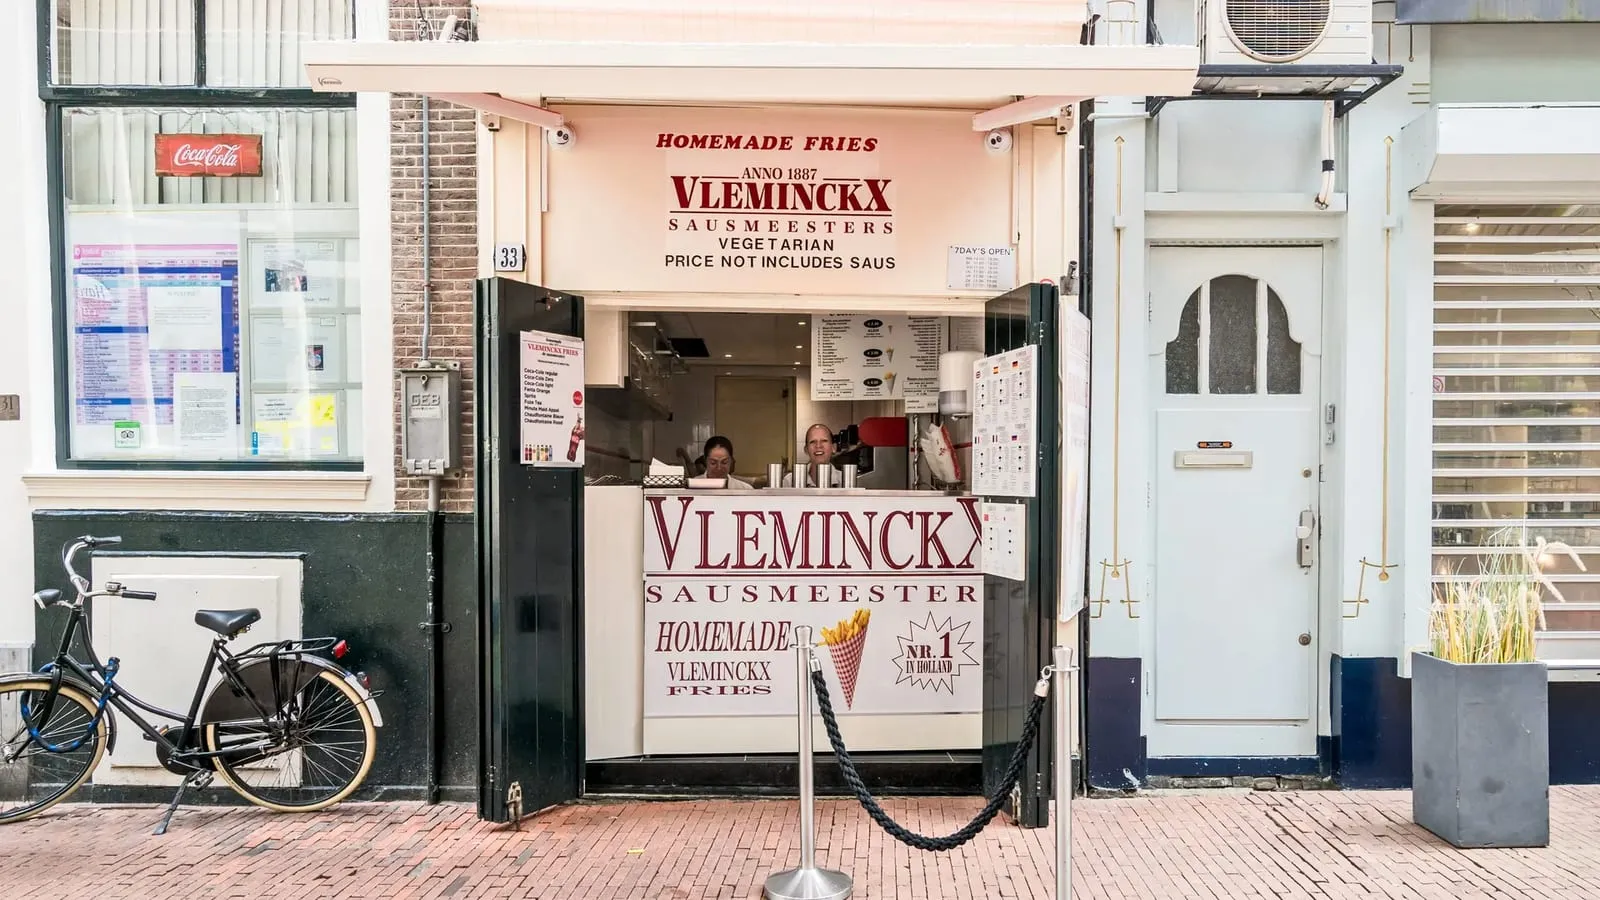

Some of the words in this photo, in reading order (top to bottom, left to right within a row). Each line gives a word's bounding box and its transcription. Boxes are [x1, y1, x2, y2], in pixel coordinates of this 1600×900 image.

[656, 134, 793, 150] HOMEMADE
[804, 136, 878, 152] FRIES
[742, 167, 783, 180] ANNO
[787, 168, 817, 180] 1887
[670, 175, 892, 212] VLEMINCKX
[668, 219, 893, 234] SAUSMEESTERS
[718, 237, 834, 251] VEGETARIAN
[954, 246, 986, 255] 7DAY'S
[988, 248, 1011, 256] OPEN
[500, 247, 518, 268] 33
[665, 255, 714, 267] PRICE
[721, 256, 757, 268] NOT
[762, 256, 843, 268] INCLUDES
[850, 256, 896, 269] SAUS
[528, 343, 562, 354] VLEMINCKX
[562, 348, 579, 356] FRIES
[411, 394, 440, 407] GEB
[645, 585, 977, 603] SAUSMEESTER
[655, 621, 791, 652] HOMEMADE
[907, 645, 936, 659] NR.
[940, 632, 953, 659] 1
[667, 661, 772, 681] VLEMINCKX
[906, 660, 914, 674] IN
[916, 660, 953, 674] HOLLAND
[667, 685, 772, 696] FRIES
